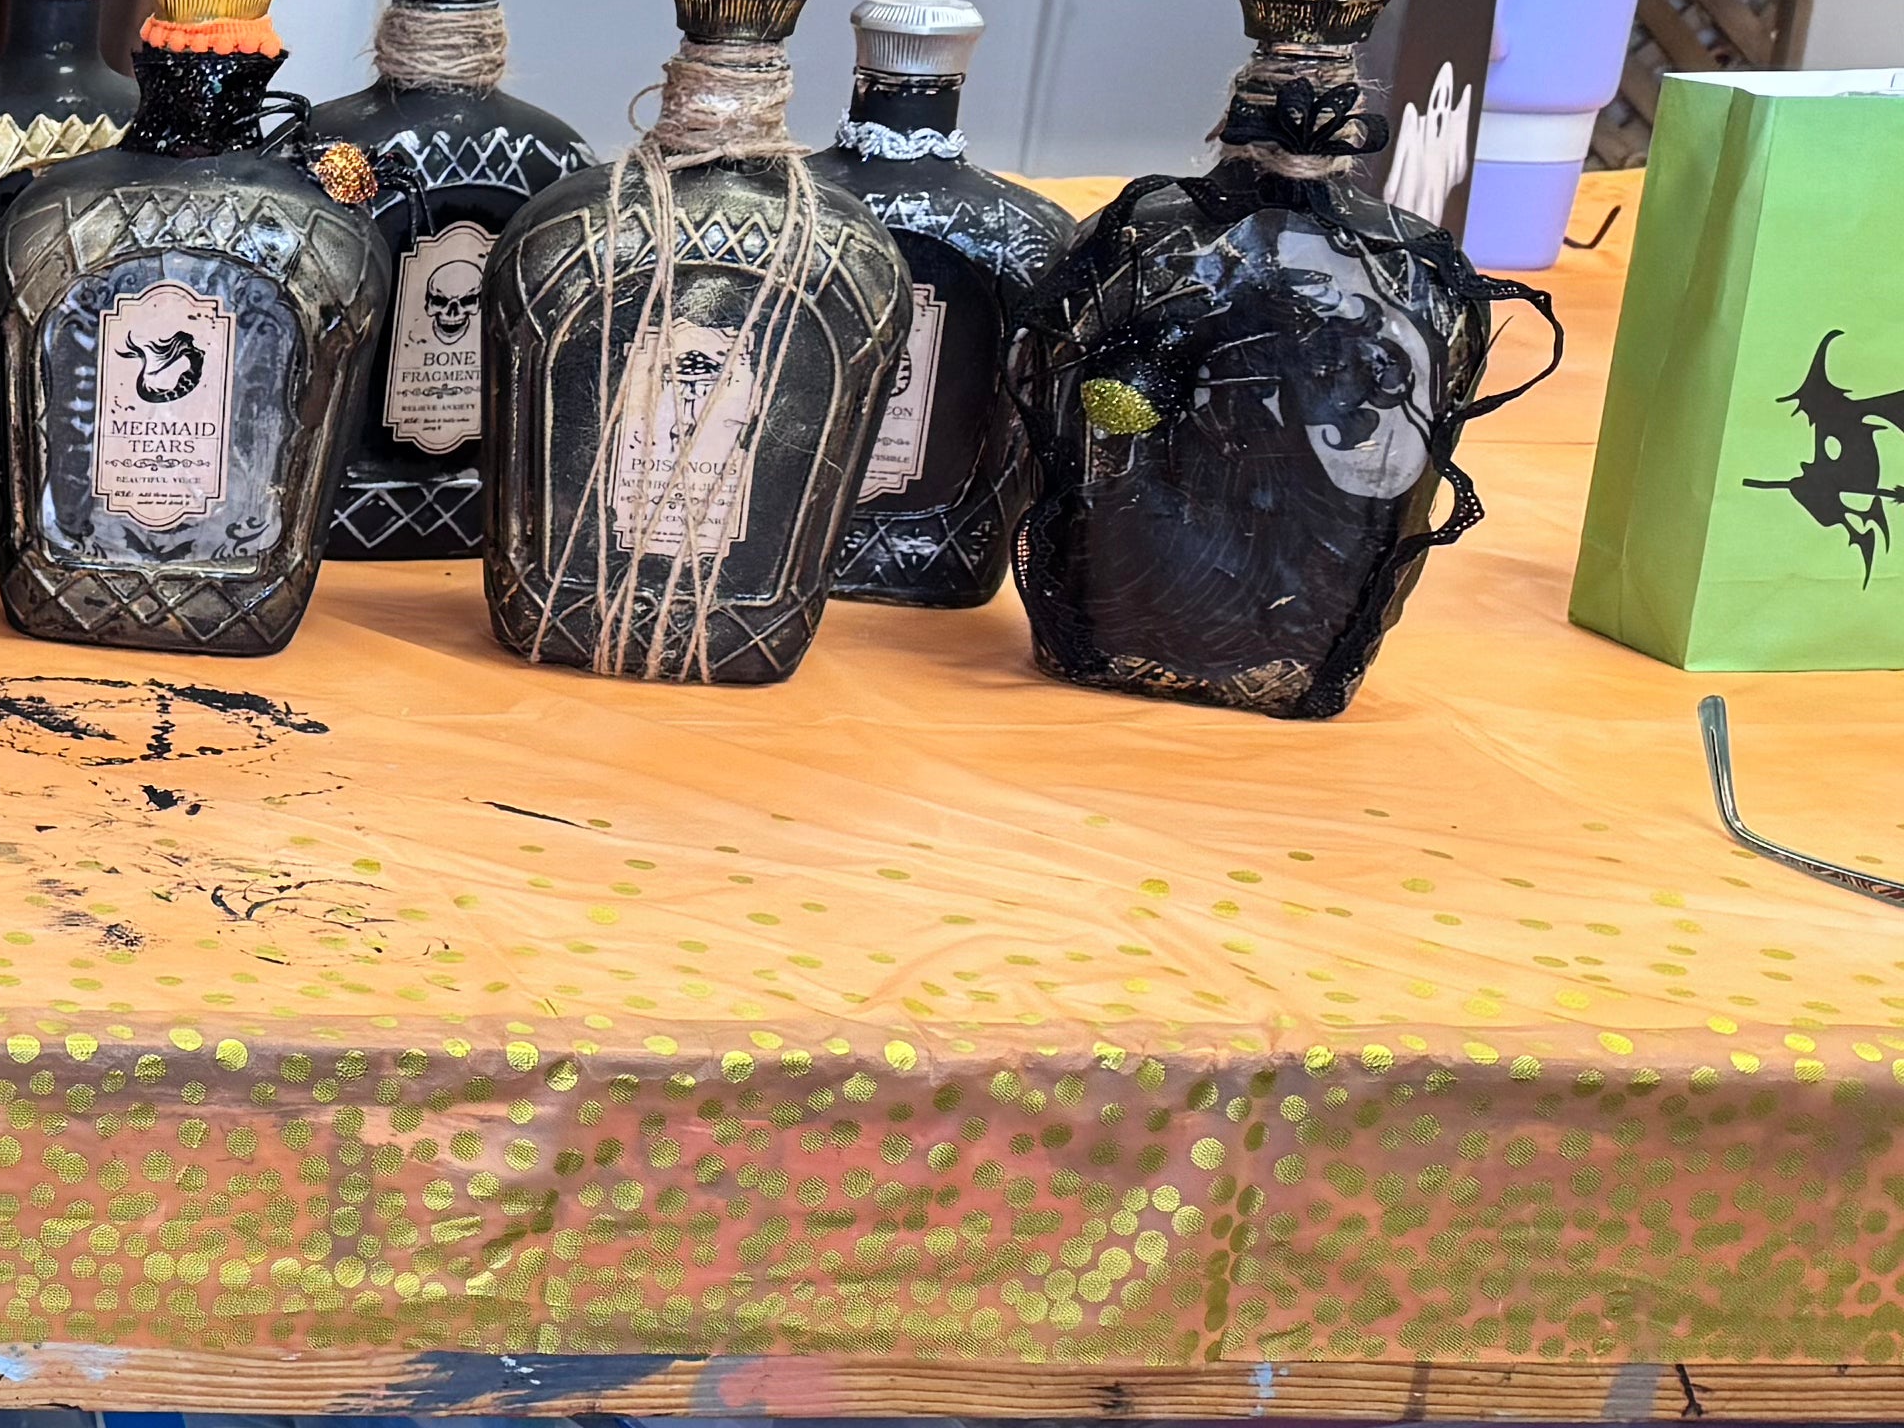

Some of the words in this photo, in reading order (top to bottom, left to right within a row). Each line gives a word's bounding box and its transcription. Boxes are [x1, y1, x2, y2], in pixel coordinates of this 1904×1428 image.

[423, 351, 477, 367] BONE
[111, 420, 217, 437] MERMAID
[128, 439, 196, 454] TEARS
